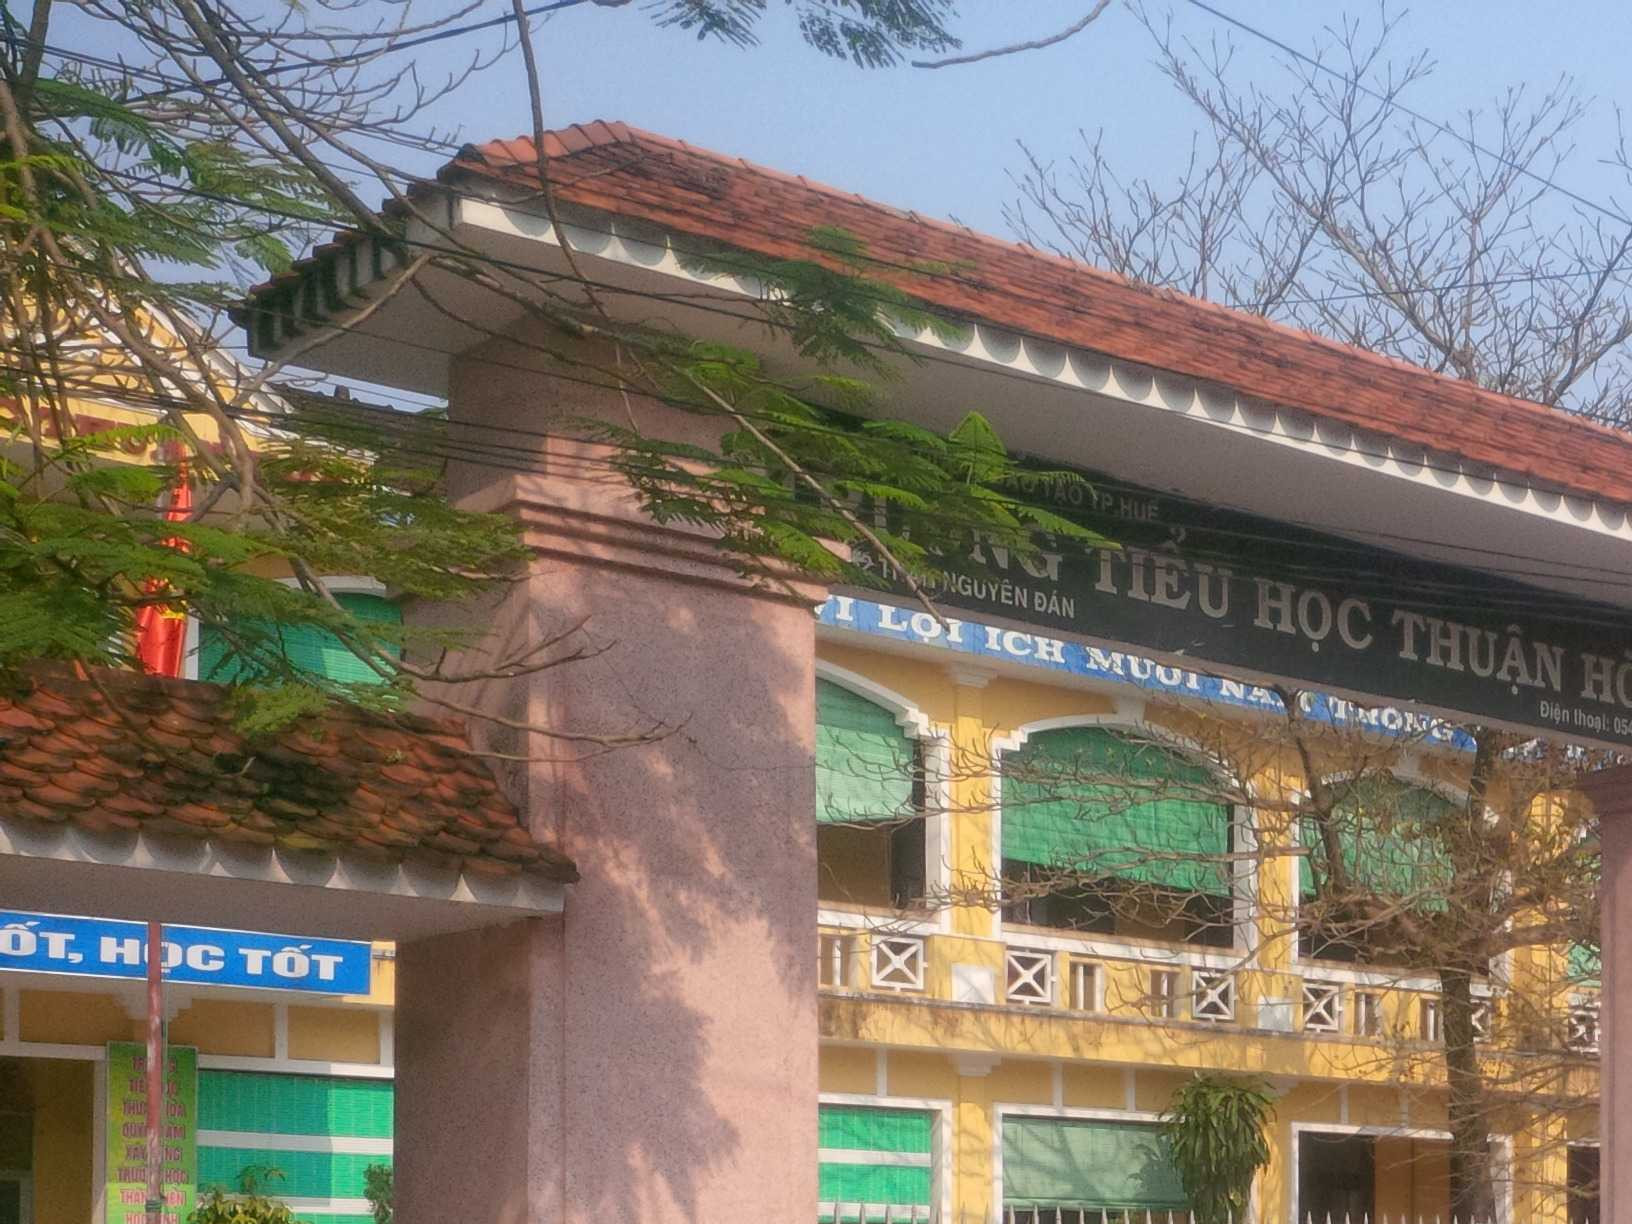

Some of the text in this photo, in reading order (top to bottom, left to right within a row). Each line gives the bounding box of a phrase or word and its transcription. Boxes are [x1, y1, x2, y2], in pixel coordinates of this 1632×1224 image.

[1033, 588, 1076, 619] ĐÁN
[1085, 527, 1232, 619] TIỂU
[1253, 576, 1374, 652] HỌC
[1392, 608, 1566, 695] THUẬN
[1540, 700, 1570, 725] Điện
[101, 937, 225, 975] HỌC
[238, 944, 344, 981] TỐT
